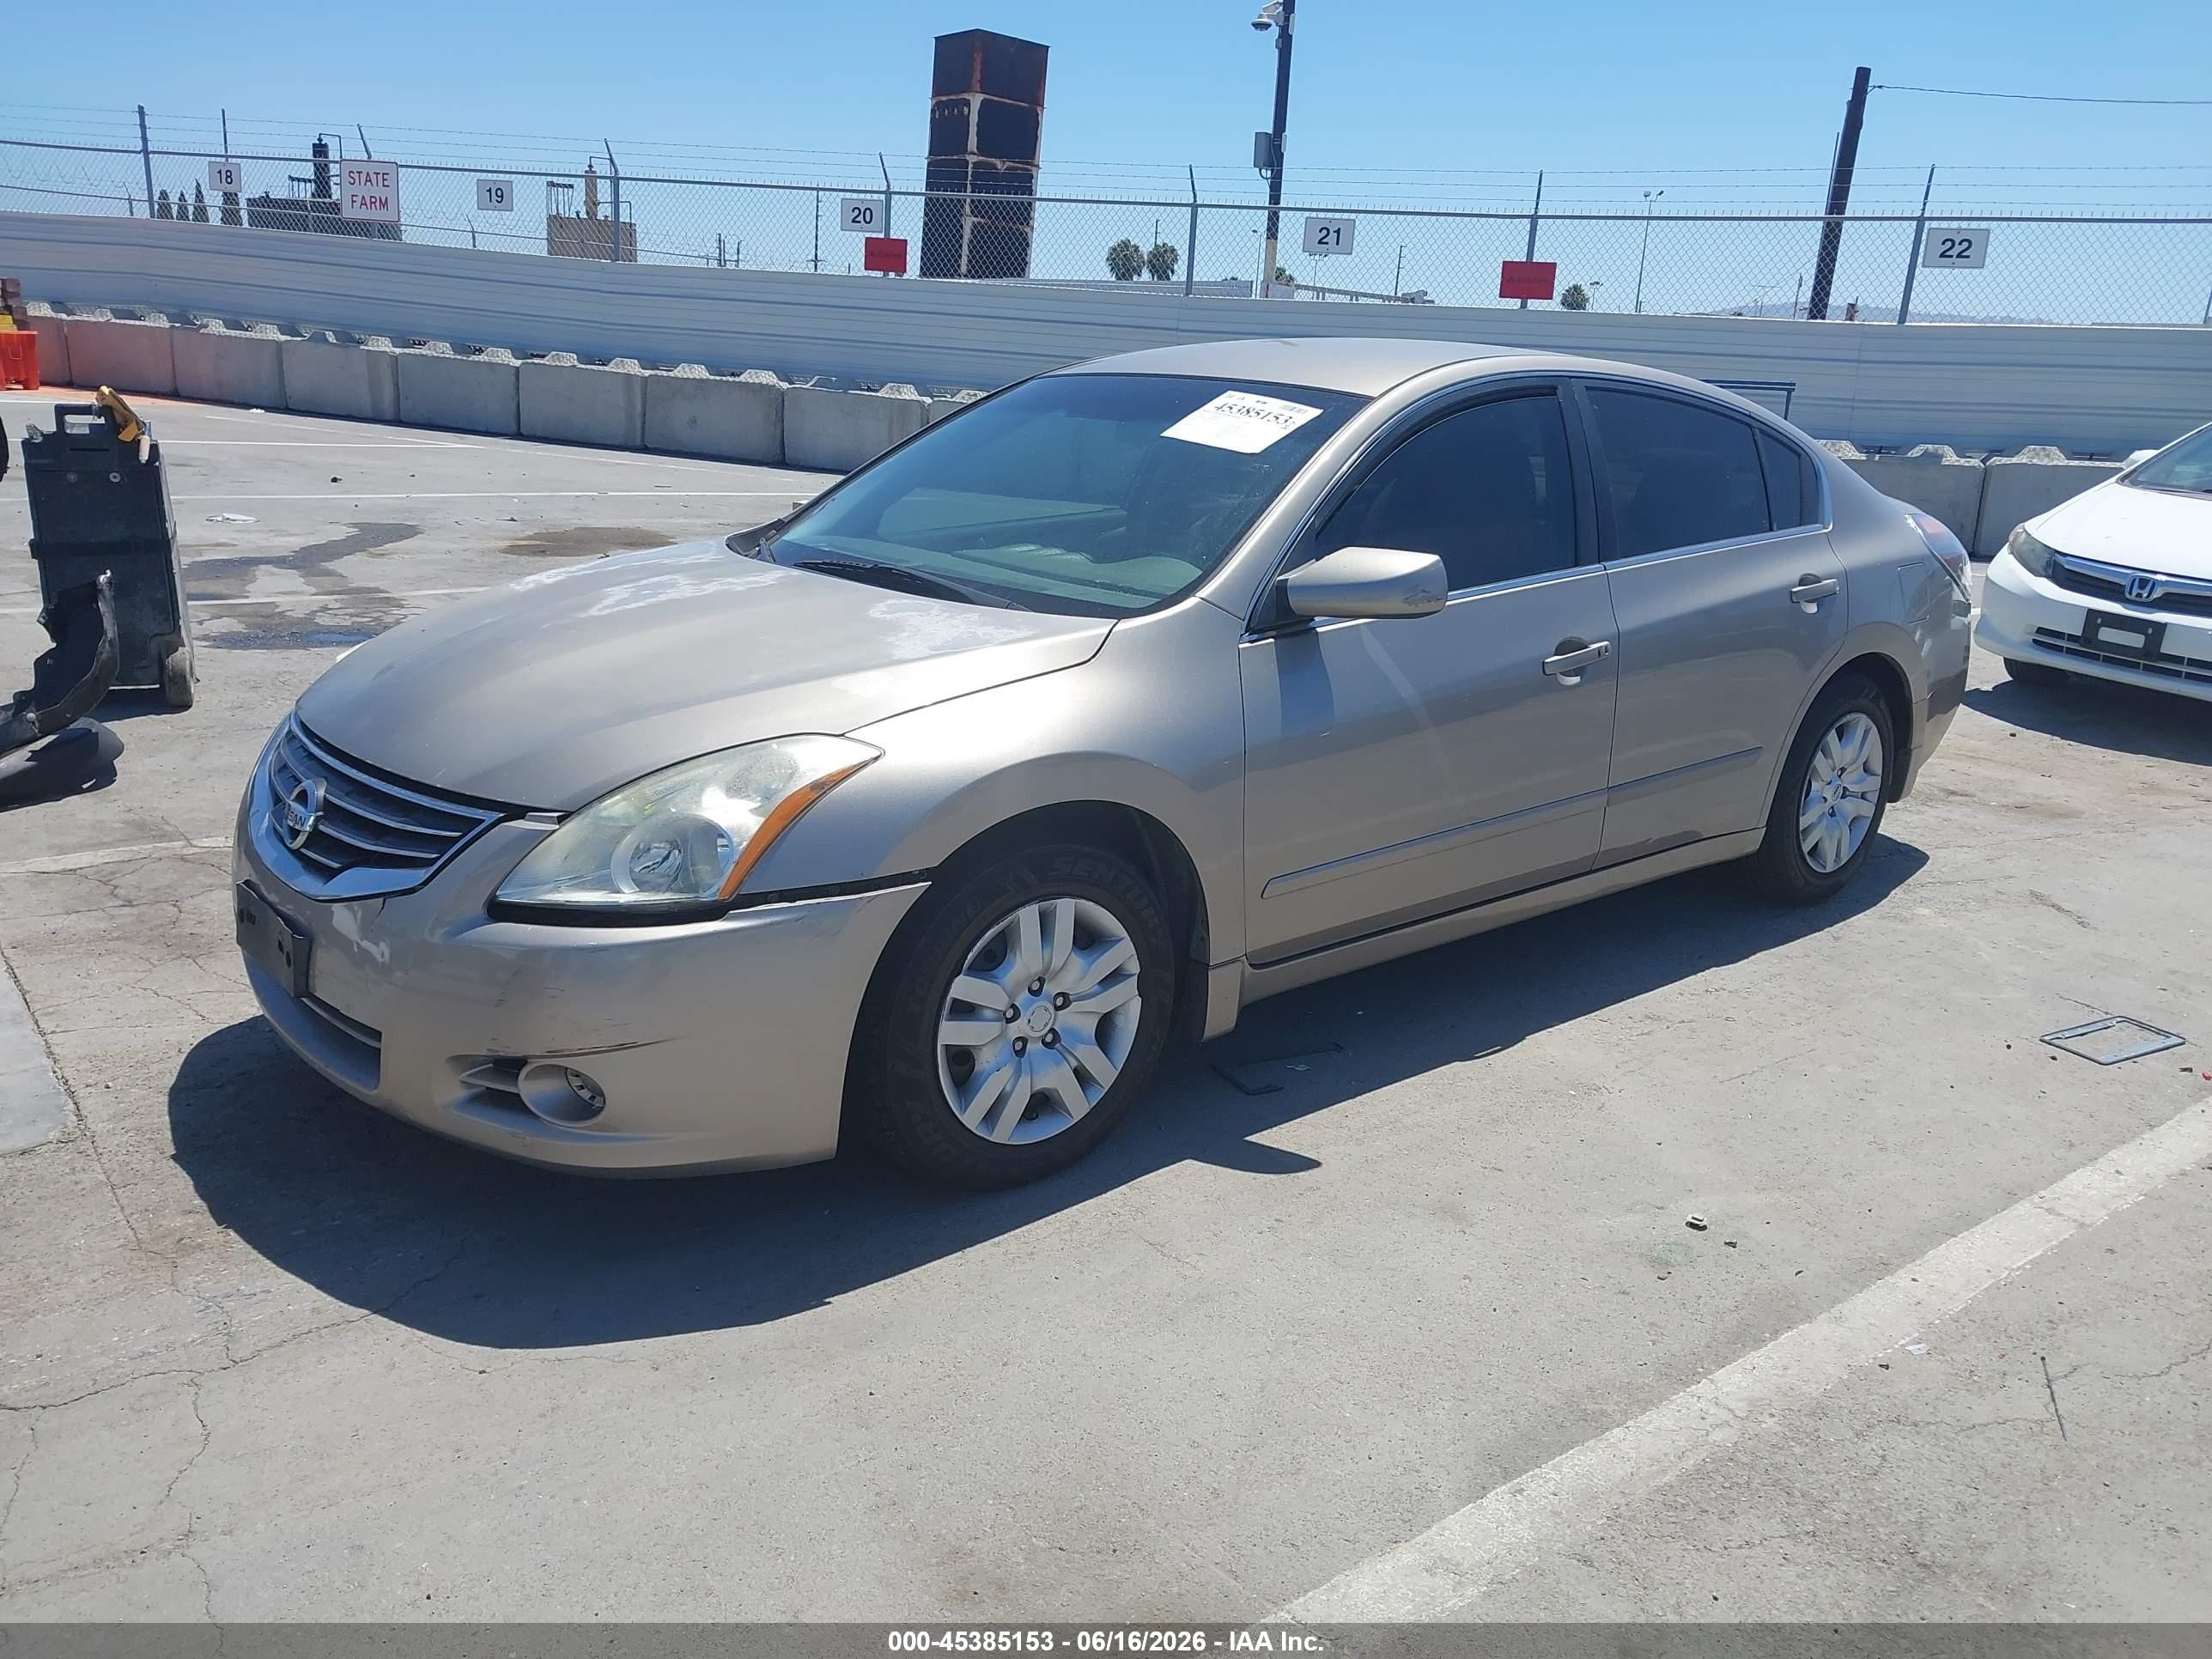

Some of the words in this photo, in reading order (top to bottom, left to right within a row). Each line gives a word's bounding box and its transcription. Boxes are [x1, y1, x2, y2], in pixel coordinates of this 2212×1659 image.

[217, 168, 233, 185] 18
[348, 170, 390, 187] STATE
[351, 194, 389, 212] FARM
[486, 187, 504, 204] 19
[851, 206, 873, 224] 20
[1317, 227, 1340, 246] 21
[1939, 238, 1972, 258] 22
[1214, 402, 1293, 424] 45385153
